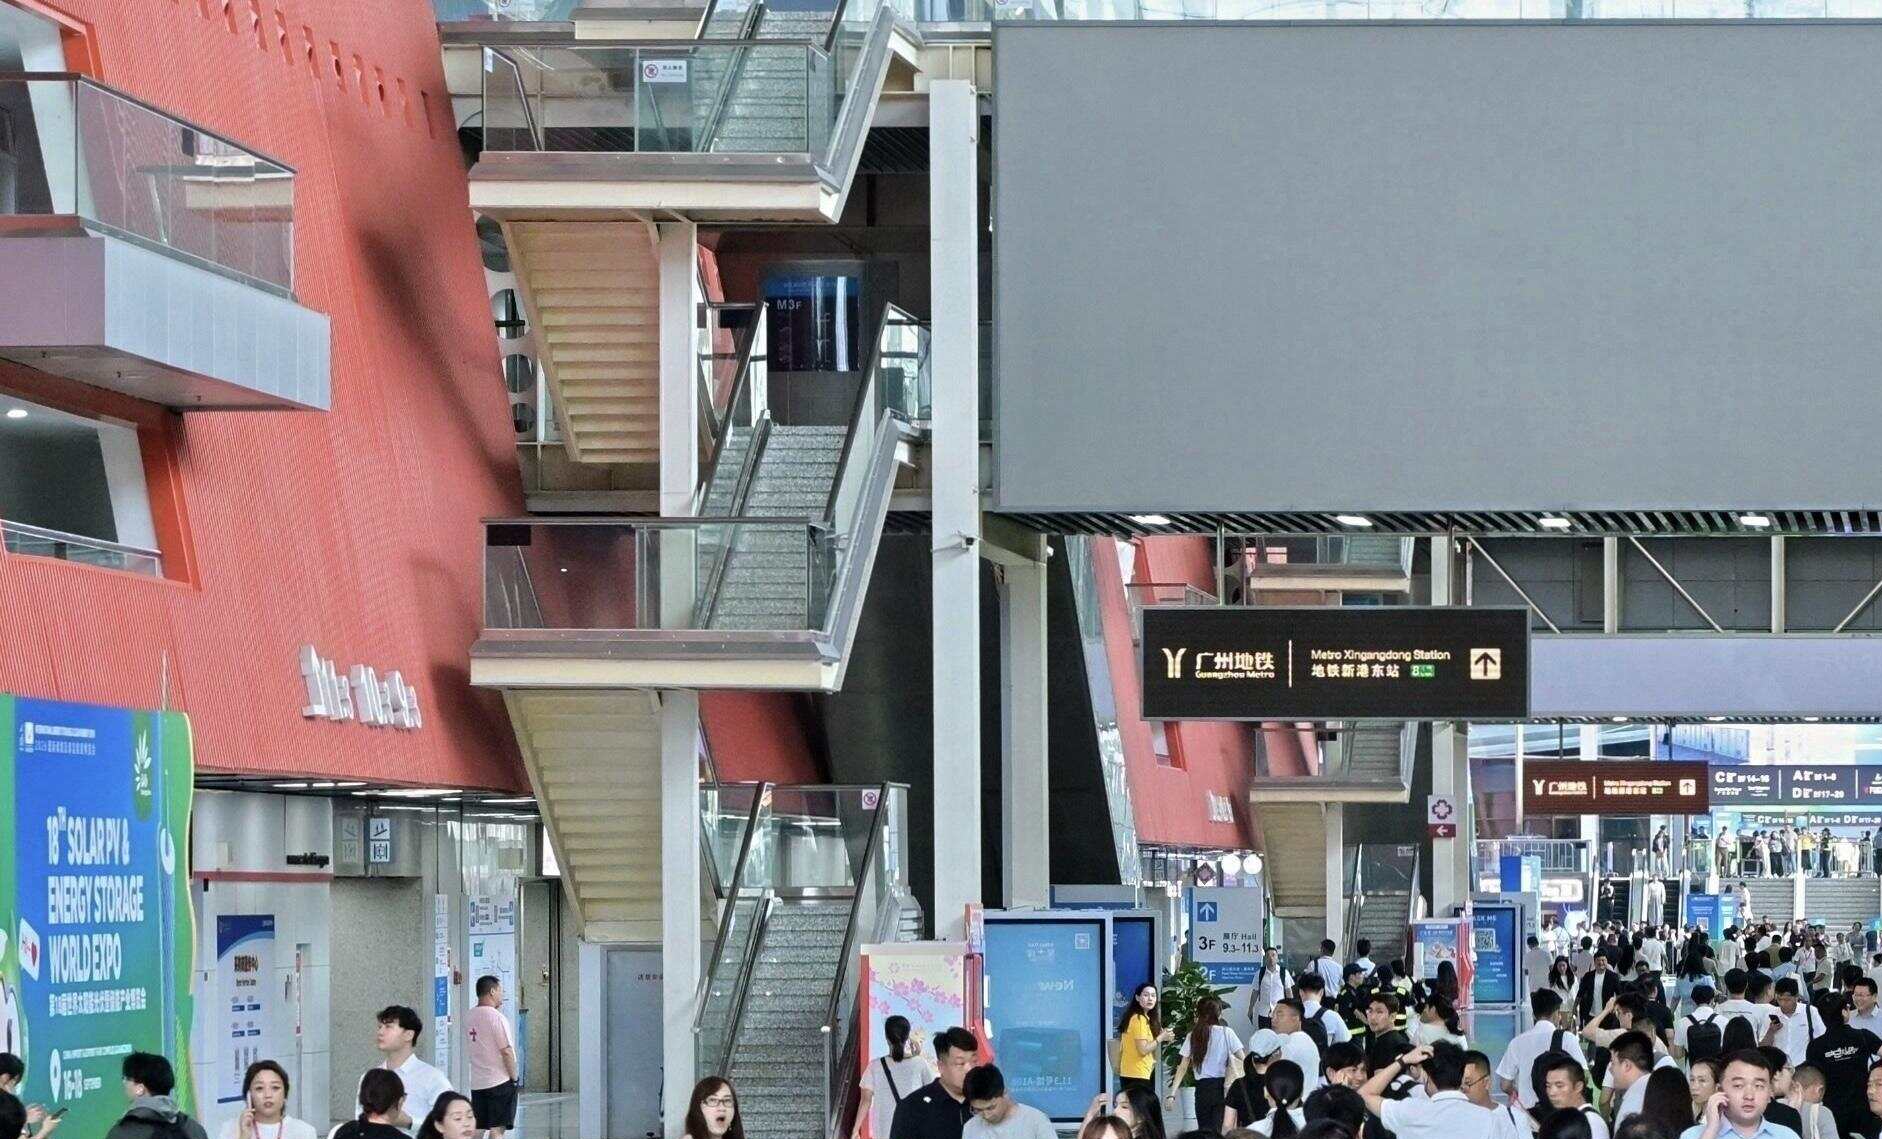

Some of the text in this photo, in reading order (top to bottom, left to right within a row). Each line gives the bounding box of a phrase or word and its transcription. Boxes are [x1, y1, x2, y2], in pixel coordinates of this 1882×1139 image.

[777, 299, 802, 311] M3F
[1196, 652, 1275, 670] 广州地铁
[1311, 649, 1450, 661] Metro Xingangdong Station
[1195, 671, 1275, 679] Guangzhou Metro
[1311, 664, 1400, 678] 地铁新港东站
[68, 816, 104, 866] SOLAR
[106, 817, 121, 866] PV
[122, 817, 130, 866] &
[48, 875, 143, 924] ENERGY STORAGE
[1241, 932, 1257, 940] Hall
[1199, 937, 1216, 950] 3F
[50, 933, 122, 983] WORLD EXPO
